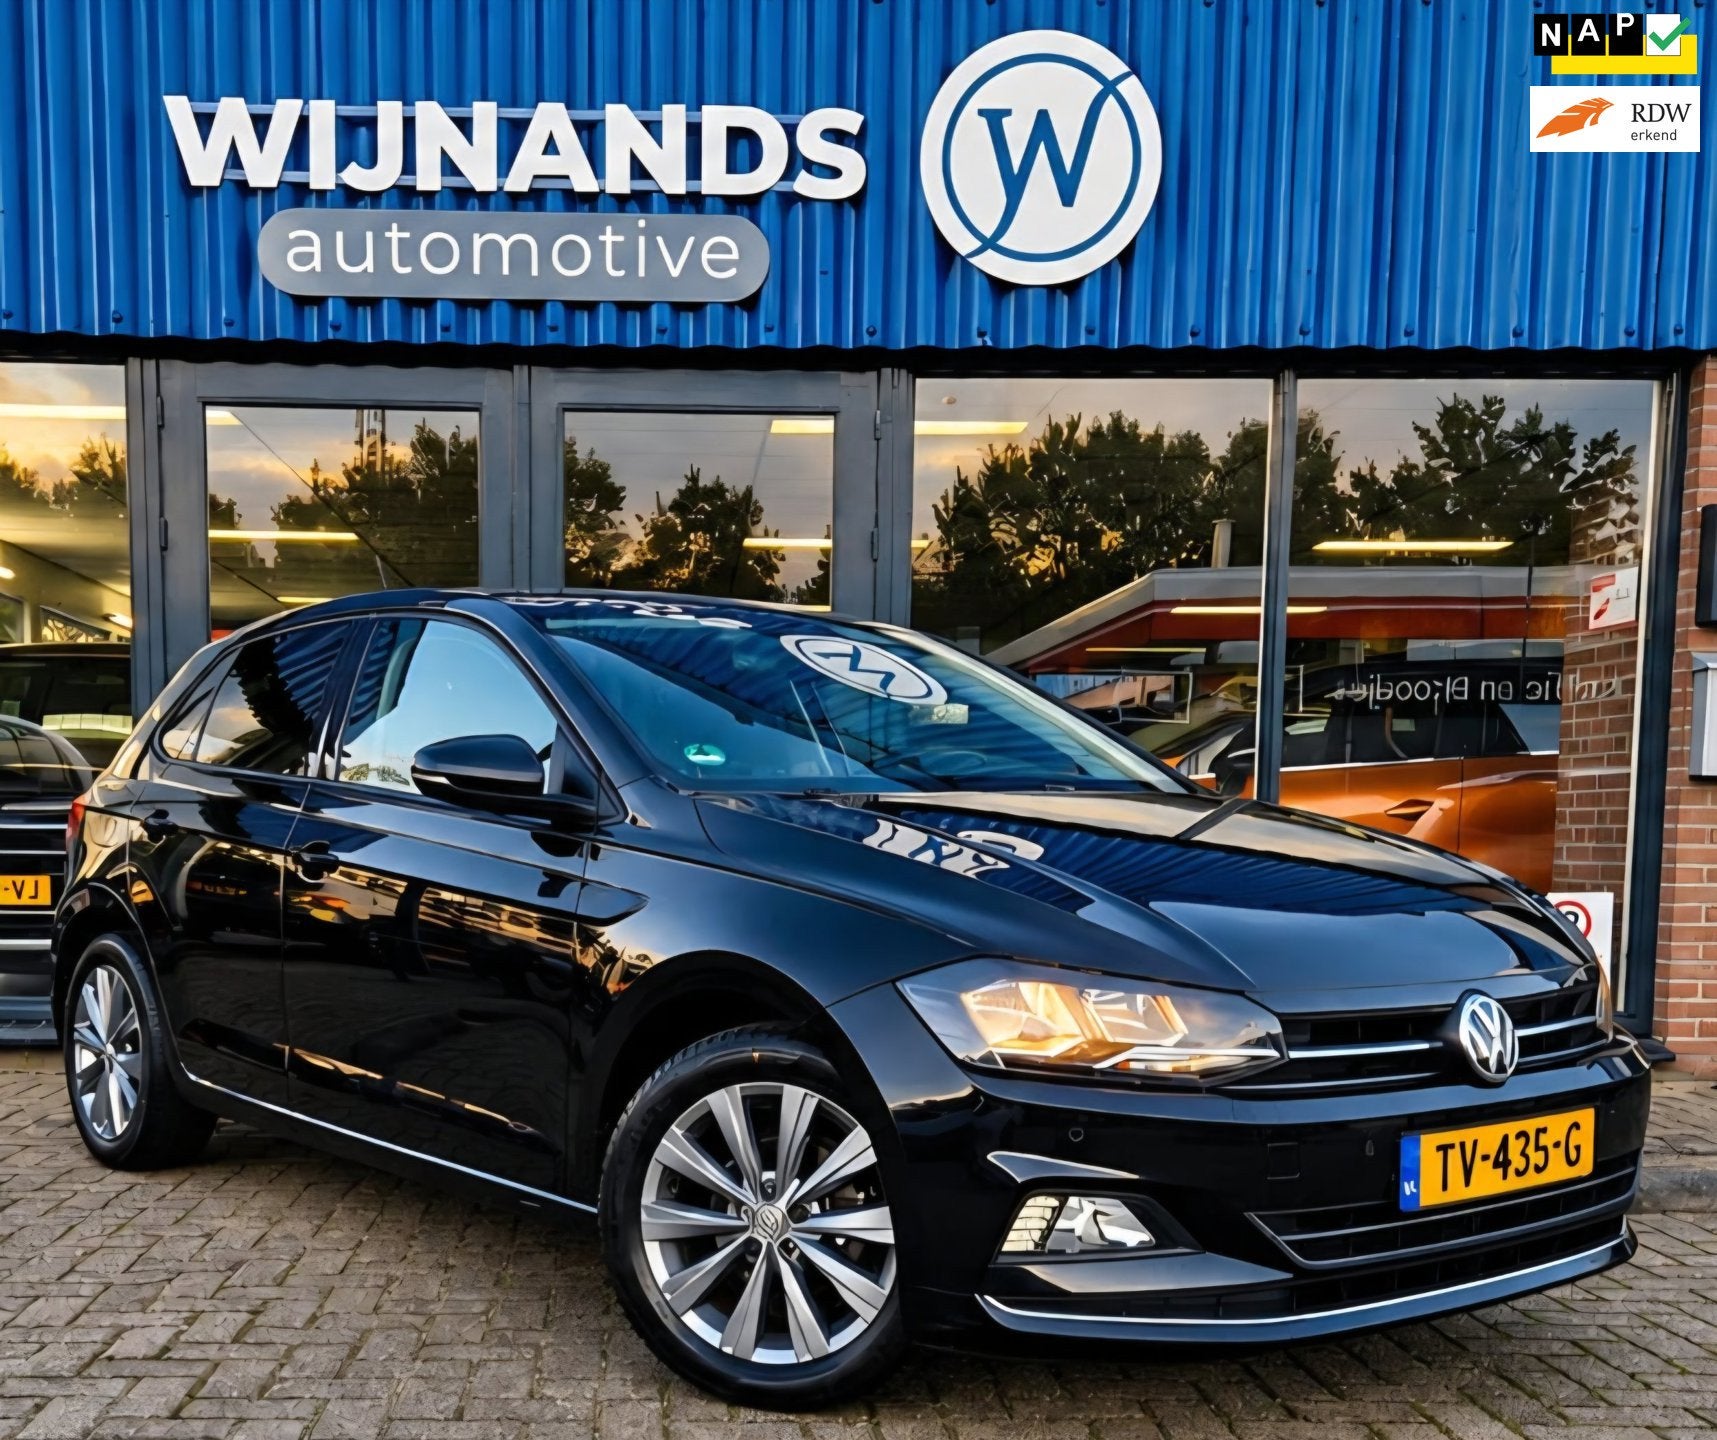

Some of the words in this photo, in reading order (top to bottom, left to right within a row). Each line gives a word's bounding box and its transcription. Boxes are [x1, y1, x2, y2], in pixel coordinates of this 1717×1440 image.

[163, 94, 868, 200] WIJNANDS
[285, 218, 741, 280] automotive
[1435, 1121, 1582, 1193] TV-435-G
